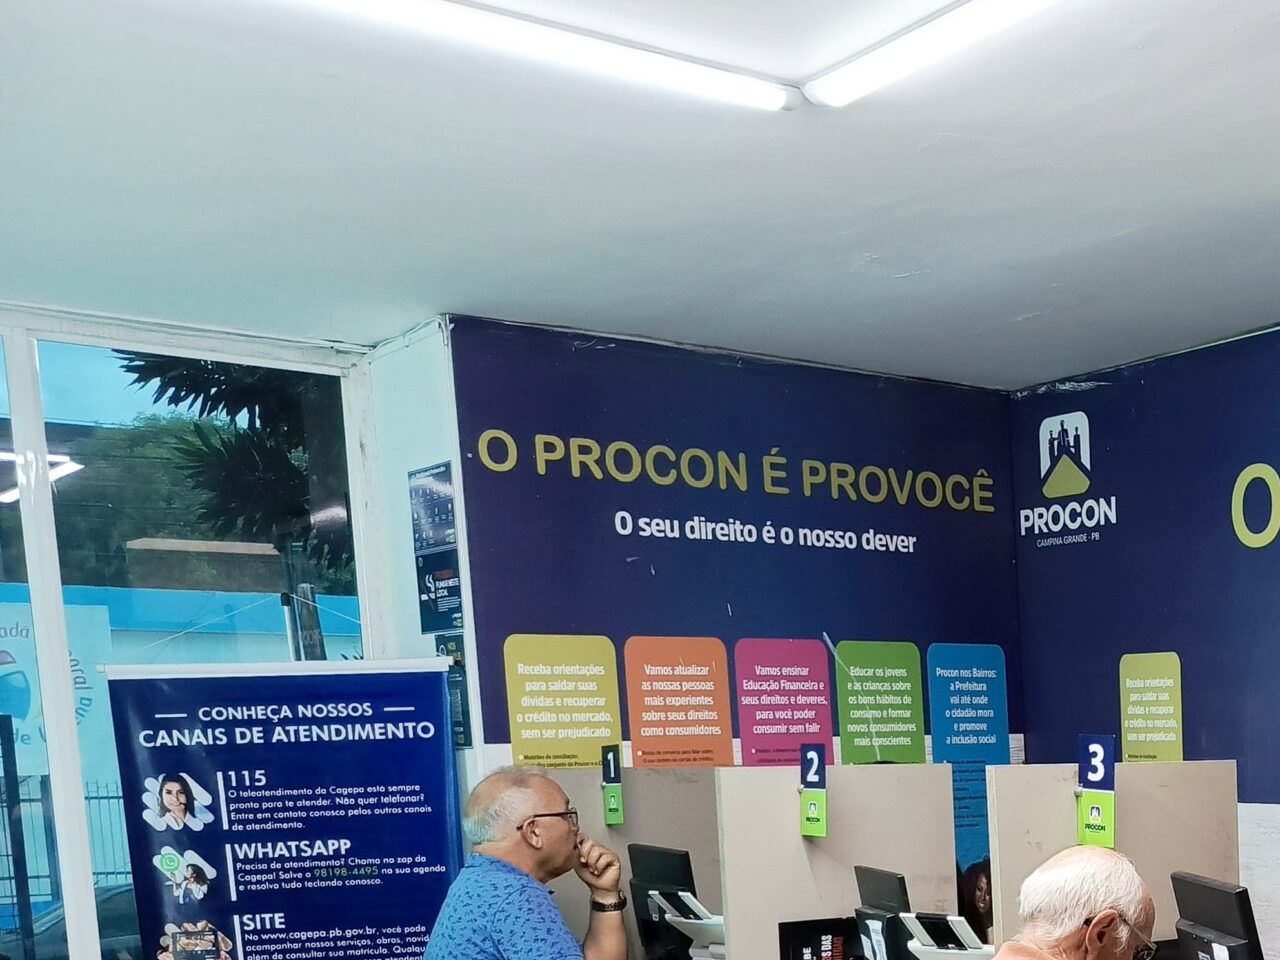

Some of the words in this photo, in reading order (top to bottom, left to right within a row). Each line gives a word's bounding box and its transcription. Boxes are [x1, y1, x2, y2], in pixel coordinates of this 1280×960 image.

[477, 429, 519, 473] O
[534, 434, 748, 493] PROCON
[762, 447, 790, 495] É
[801, 459, 995, 514] PROVOCÊ
[1019, 495, 1117, 536] PROCON
[614, 510, 633, 536] O
[638, 517, 680, 539] seu
[685, 515, 757, 543] direito
[762, 520, 775, 544] é
[780, 526, 794, 545] o
[798, 526, 857, 550] nosso
[861, 528, 917, 553] dever
[1036, 537, 1063, 548] CAMPINA
[1063, 533, 1088, 545] GRANDE
[517, 663, 551, 676] Receba
[552, 663, 606, 677] orientações
[643, 663, 673, 676] Vamos
[673, 664, 710, 676] atualizar
[754, 664, 781, 676] Vamos
[781, 665, 810, 676] ensinar
[525, 681, 547, 692] para
[547, 680, 576, 691] saldar
[577, 681, 599, 692] suas
[641, 681, 652, 690] as
[652, 681, 681, 691] nossas
[682, 681, 715, 692] pessoas
[742, 679, 779, 692] Educação
[780, 679, 818, 691] Financeira
[819, 681, 825, 690] e
[555, 697, 562, 707] e
[563, 696, 606, 708] recuperar
[644, 695, 665, 706] mais
[665, 694, 714, 707] experientes
[741, 695, 759, 705] seus
[760, 694, 789, 705] direitos
[790, 696, 796, 705] e
[796, 694, 828, 706] deveres,
[198, 704, 294, 723] CONHEÇA
[297, 702, 374, 718] NOSSOS
[516, 713, 523, 723] o
[524, 712, 557, 723] crédito
[559, 713, 570, 723] no
[641, 709, 667, 721] sobre
[667, 711, 687, 721] seus
[687, 709, 719, 721] direitos
[755, 710, 774, 721] para
[774, 708, 793, 719] você
[793, 708, 816, 720] poder
[138, 727, 228, 748] CANAIS
[234, 726, 265, 744] DE
[271, 721, 436, 743] ATENDIMENTO
[521, 729, 541, 739] sem
[542, 728, 557, 739] ser
[558, 726, 612, 740] prejudicado
[640, 726, 664, 737] como
[665, 724, 722, 736] consumidores
[752, 722, 788, 734] consumir
[788, 724, 805, 733] sem
[805, 721, 821, 733] falir
[607, 751, 615, 778] 1
[806, 750, 820, 782] 2
[1087, 743, 1105, 782] 3
[228, 769, 267, 787] 115
[230, 811, 255, 821] Entre
[256, 811, 272, 820] em
[273, 809, 308, 819] contato
[308, 808, 346, 818] conosco
[373, 805, 403, 815] outros
[1084, 823, 1106, 832] PROCON
[234, 838, 352, 860] WHATSAPP
[242, 912, 286, 931] SITE
[244, 932, 260, 942] No
[821, 934, 833, 951] DAS
